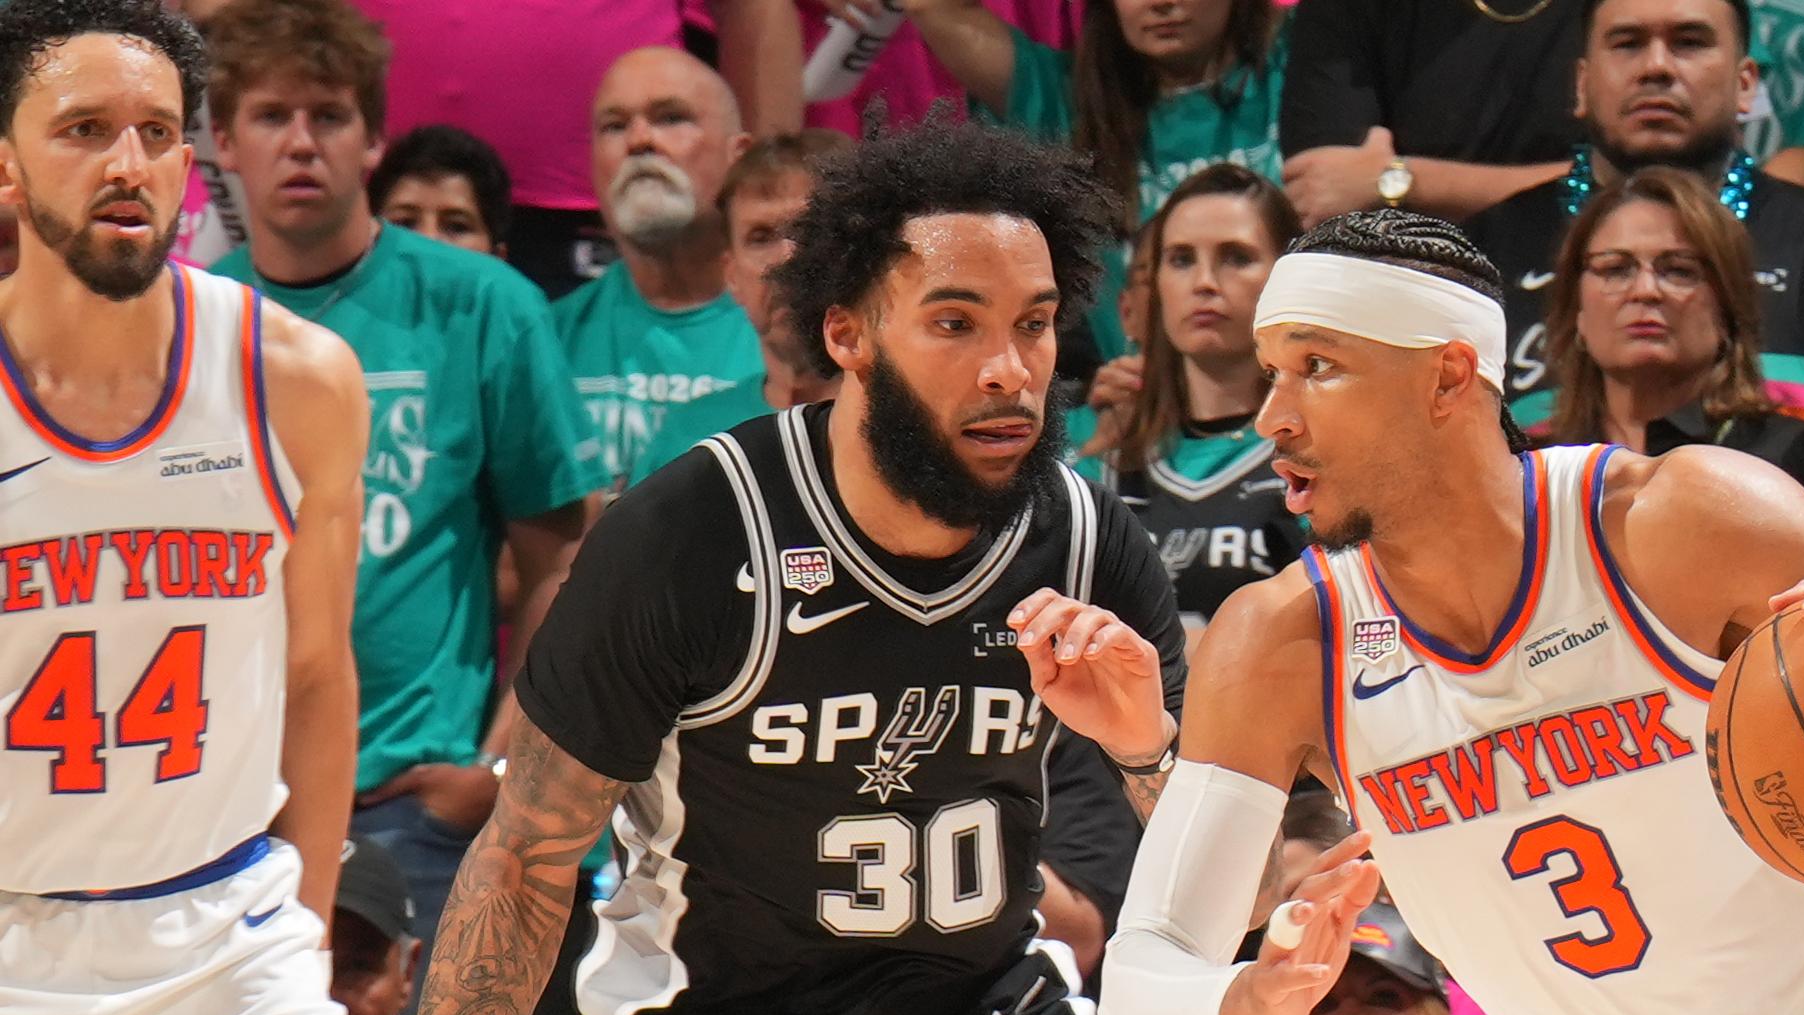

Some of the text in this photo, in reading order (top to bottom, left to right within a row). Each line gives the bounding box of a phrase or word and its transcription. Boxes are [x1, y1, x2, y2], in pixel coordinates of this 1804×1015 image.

[160, 461, 193, 477] abu
[195, 452, 244, 473] dhabi
[0, 528, 274, 614] EW YORK
[786, 555, 825, 567] USA
[787, 571, 829, 584] 250
[985, 631, 1018, 648] LED
[1353, 639, 1395, 653] 250
[1355, 622, 1394, 635] USA
[1528, 616, 1611, 668] abu dhabi
[6, 623, 210, 794] 44
[1356, 734, 1501, 836] NEW
[1500, 688, 1697, 802] YORK
[817, 797, 1008, 938] 30
[1502, 814, 1653, 979] 3
